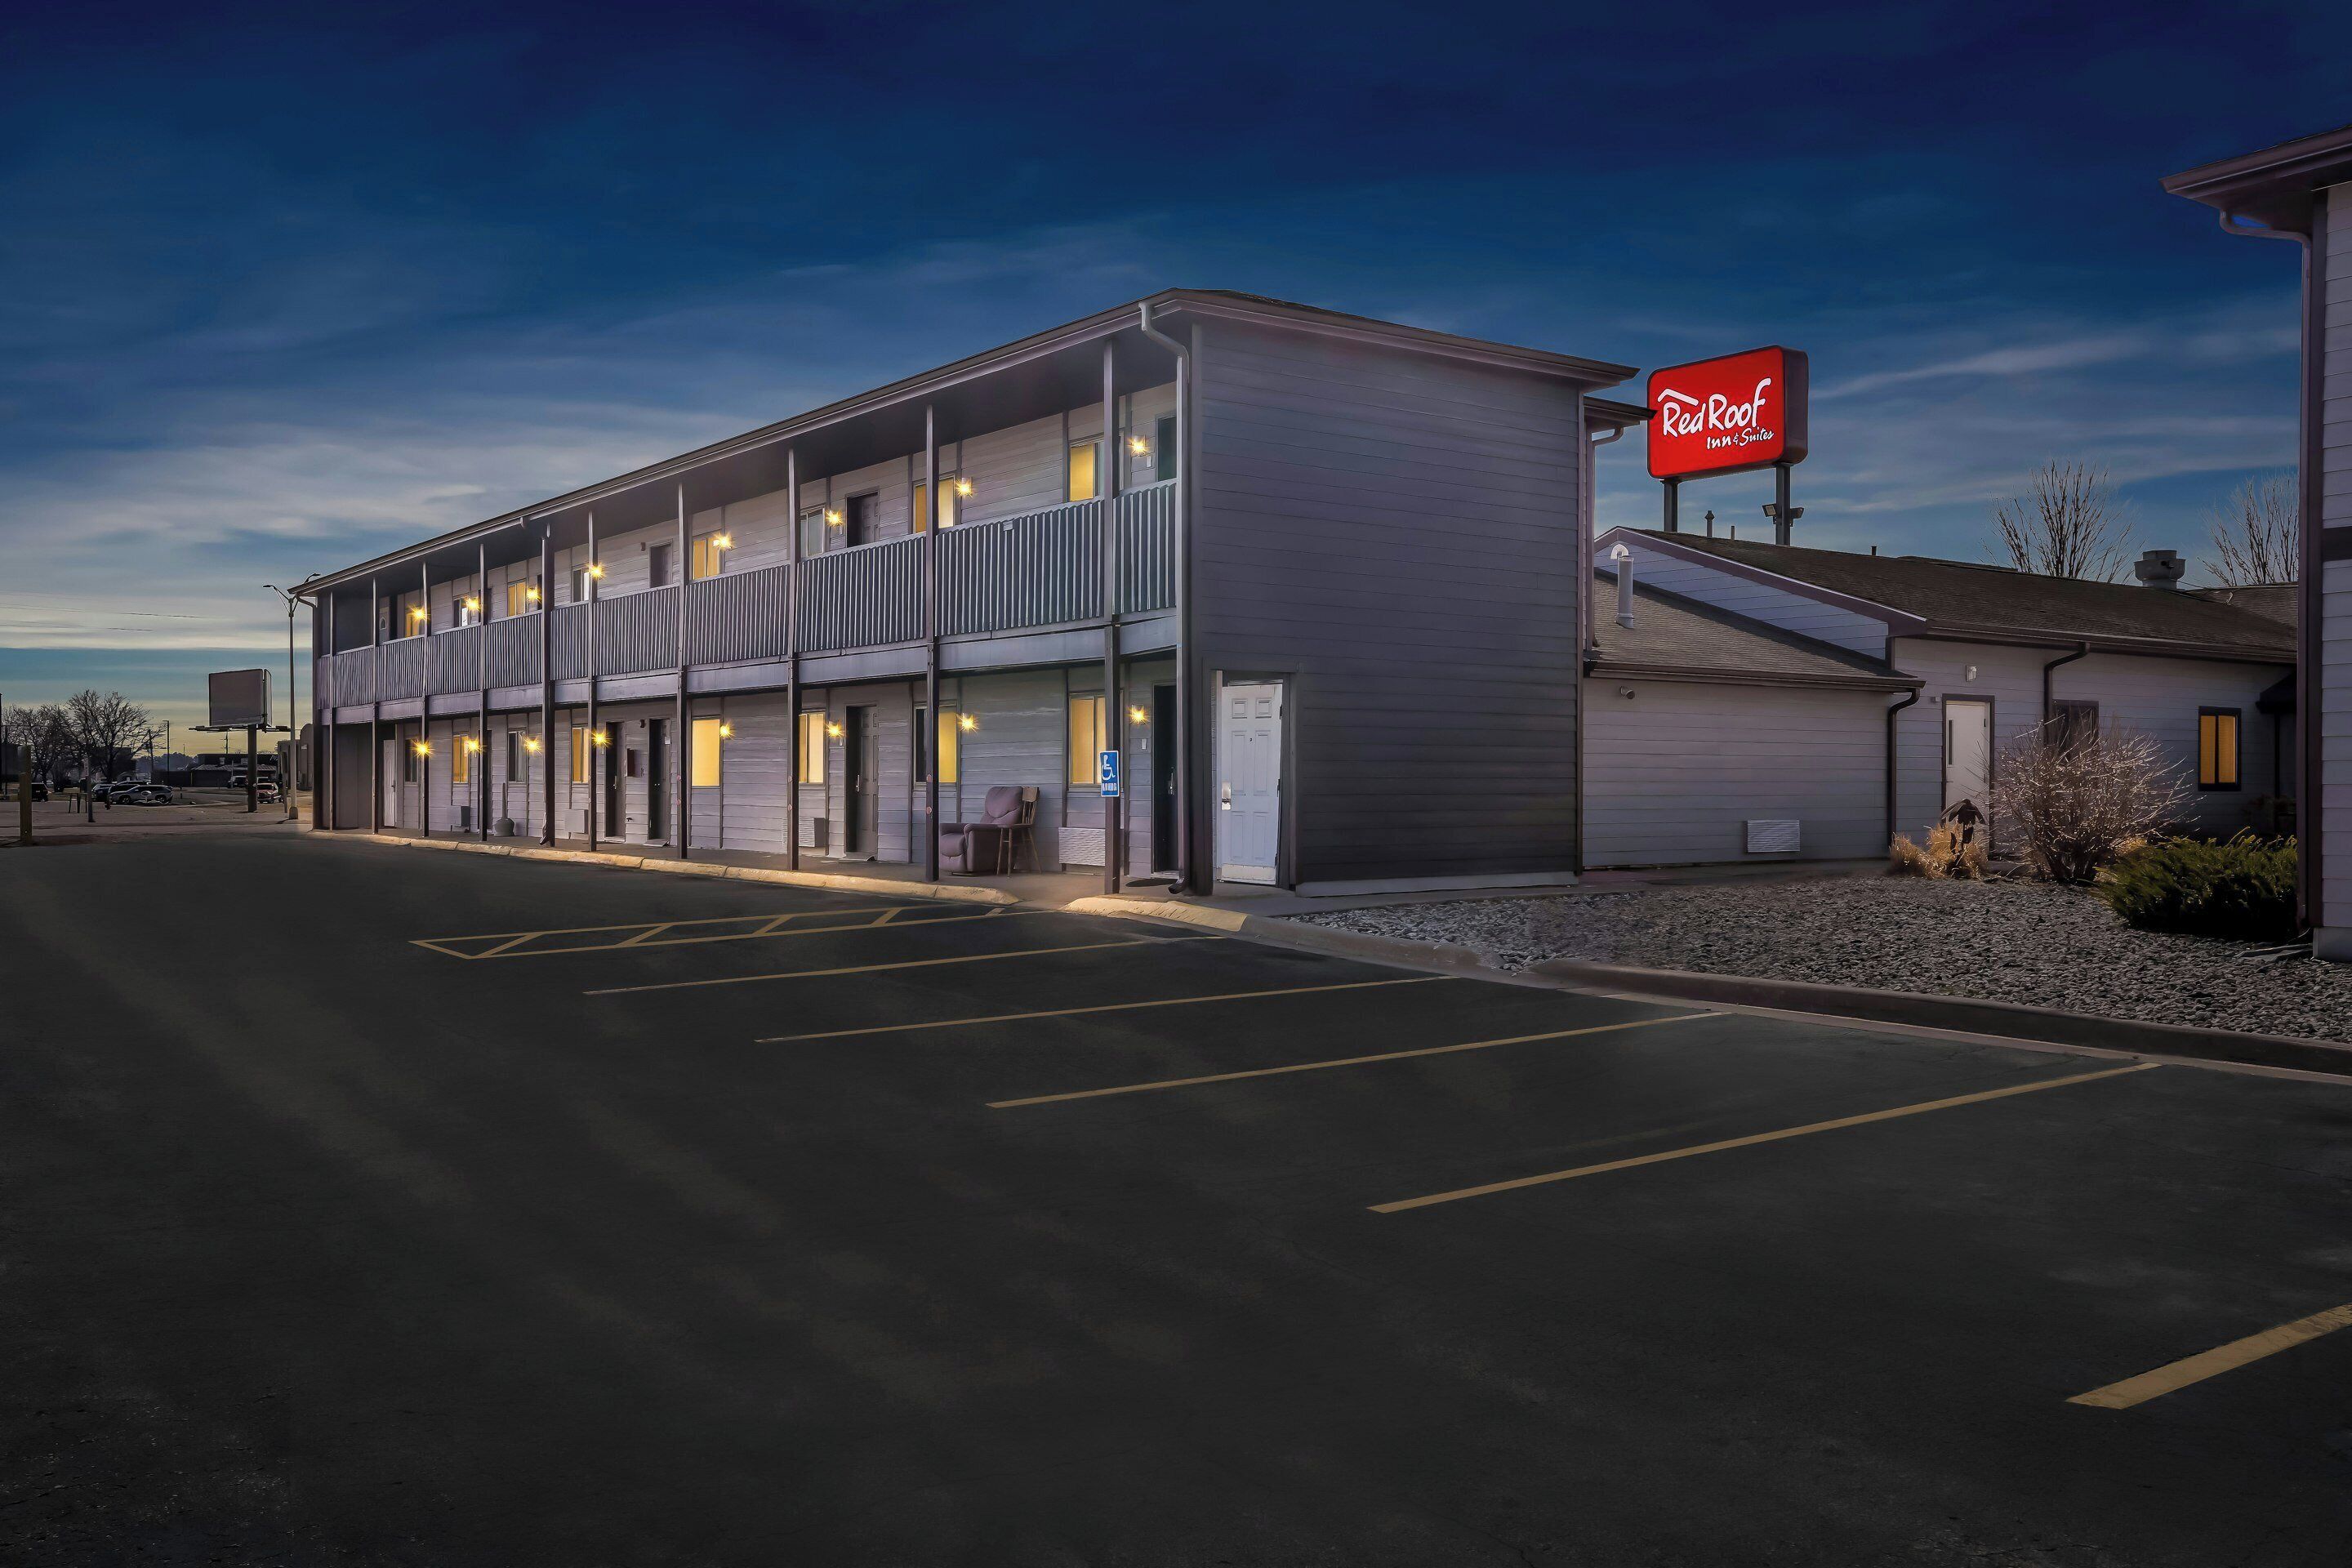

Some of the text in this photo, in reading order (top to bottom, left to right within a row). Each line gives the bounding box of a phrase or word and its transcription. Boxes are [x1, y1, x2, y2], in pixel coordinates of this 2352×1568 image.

[1663, 377, 1771, 437] Red Roof
[1707, 435, 1731, 449] Inn
[1740, 426, 1775, 447] Suites
